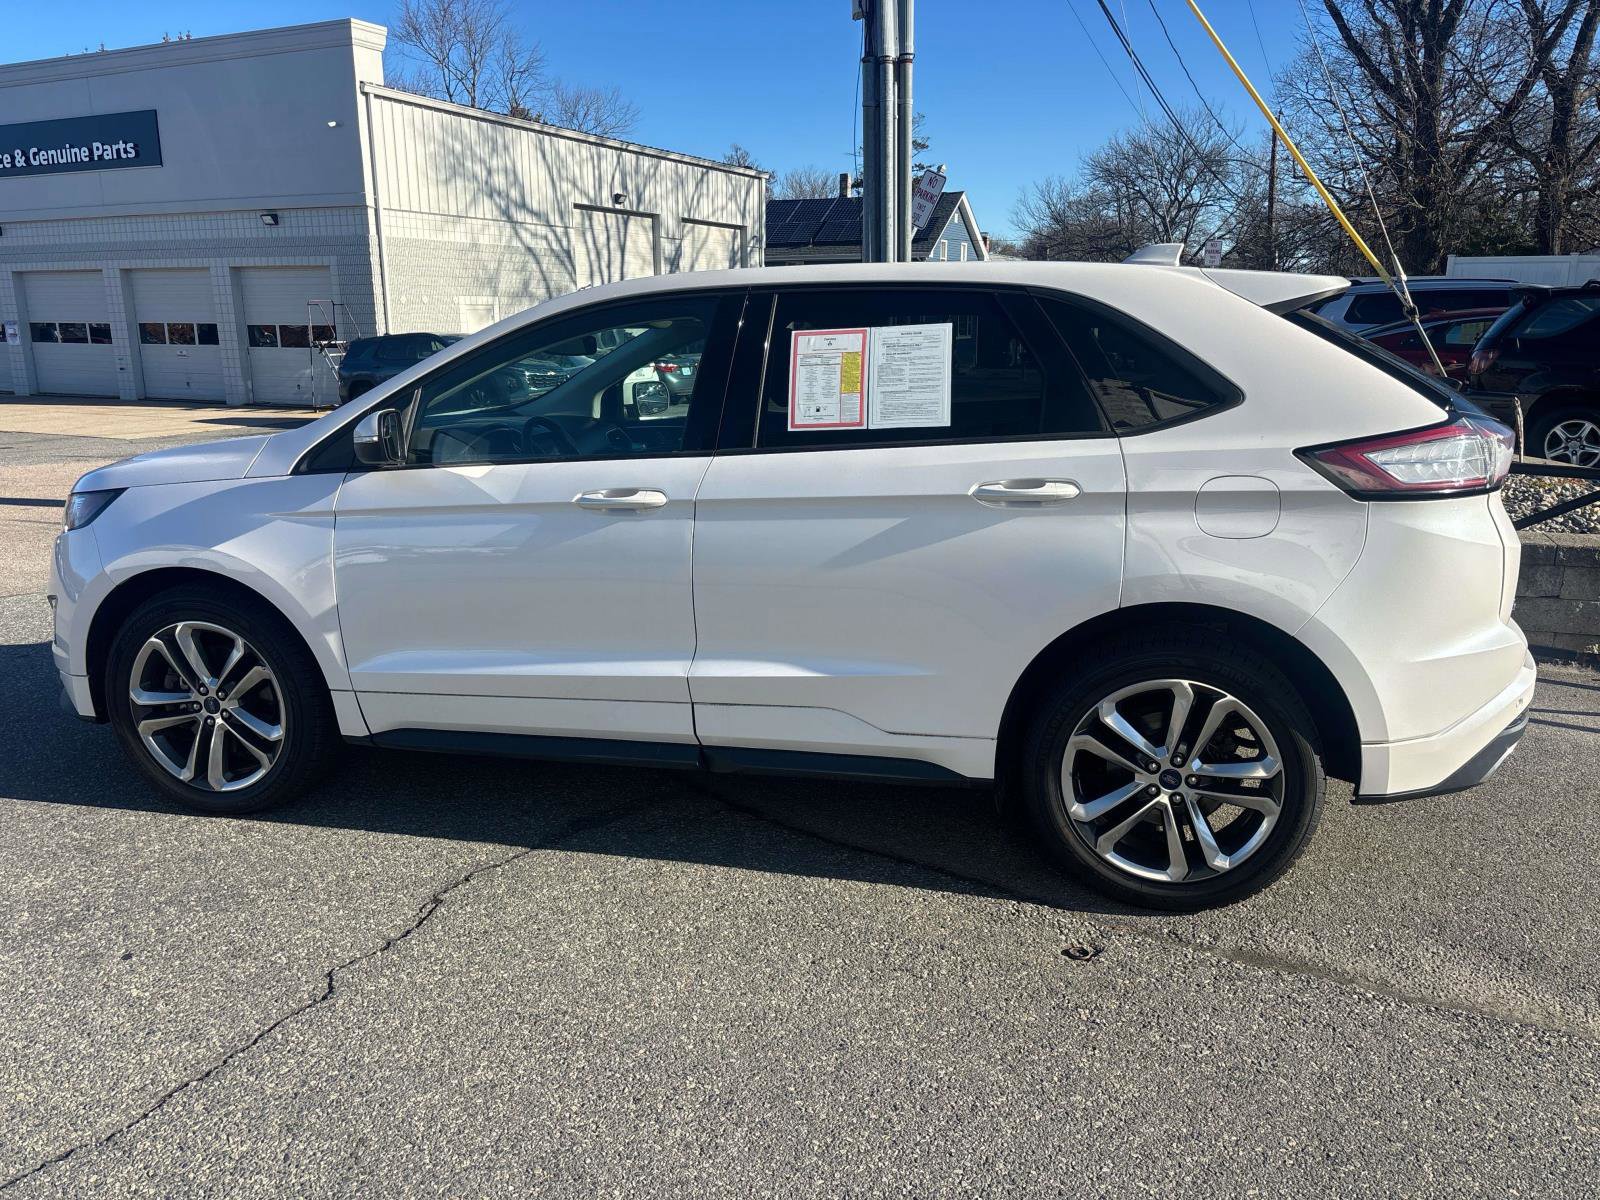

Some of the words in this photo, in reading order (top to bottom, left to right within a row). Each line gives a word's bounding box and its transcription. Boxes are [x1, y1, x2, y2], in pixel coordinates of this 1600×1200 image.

[15, 149, 27, 167] &
[29, 144, 90, 166] Genuine
[92, 140, 136, 161] Parts
[927, 175, 939, 189] NO
